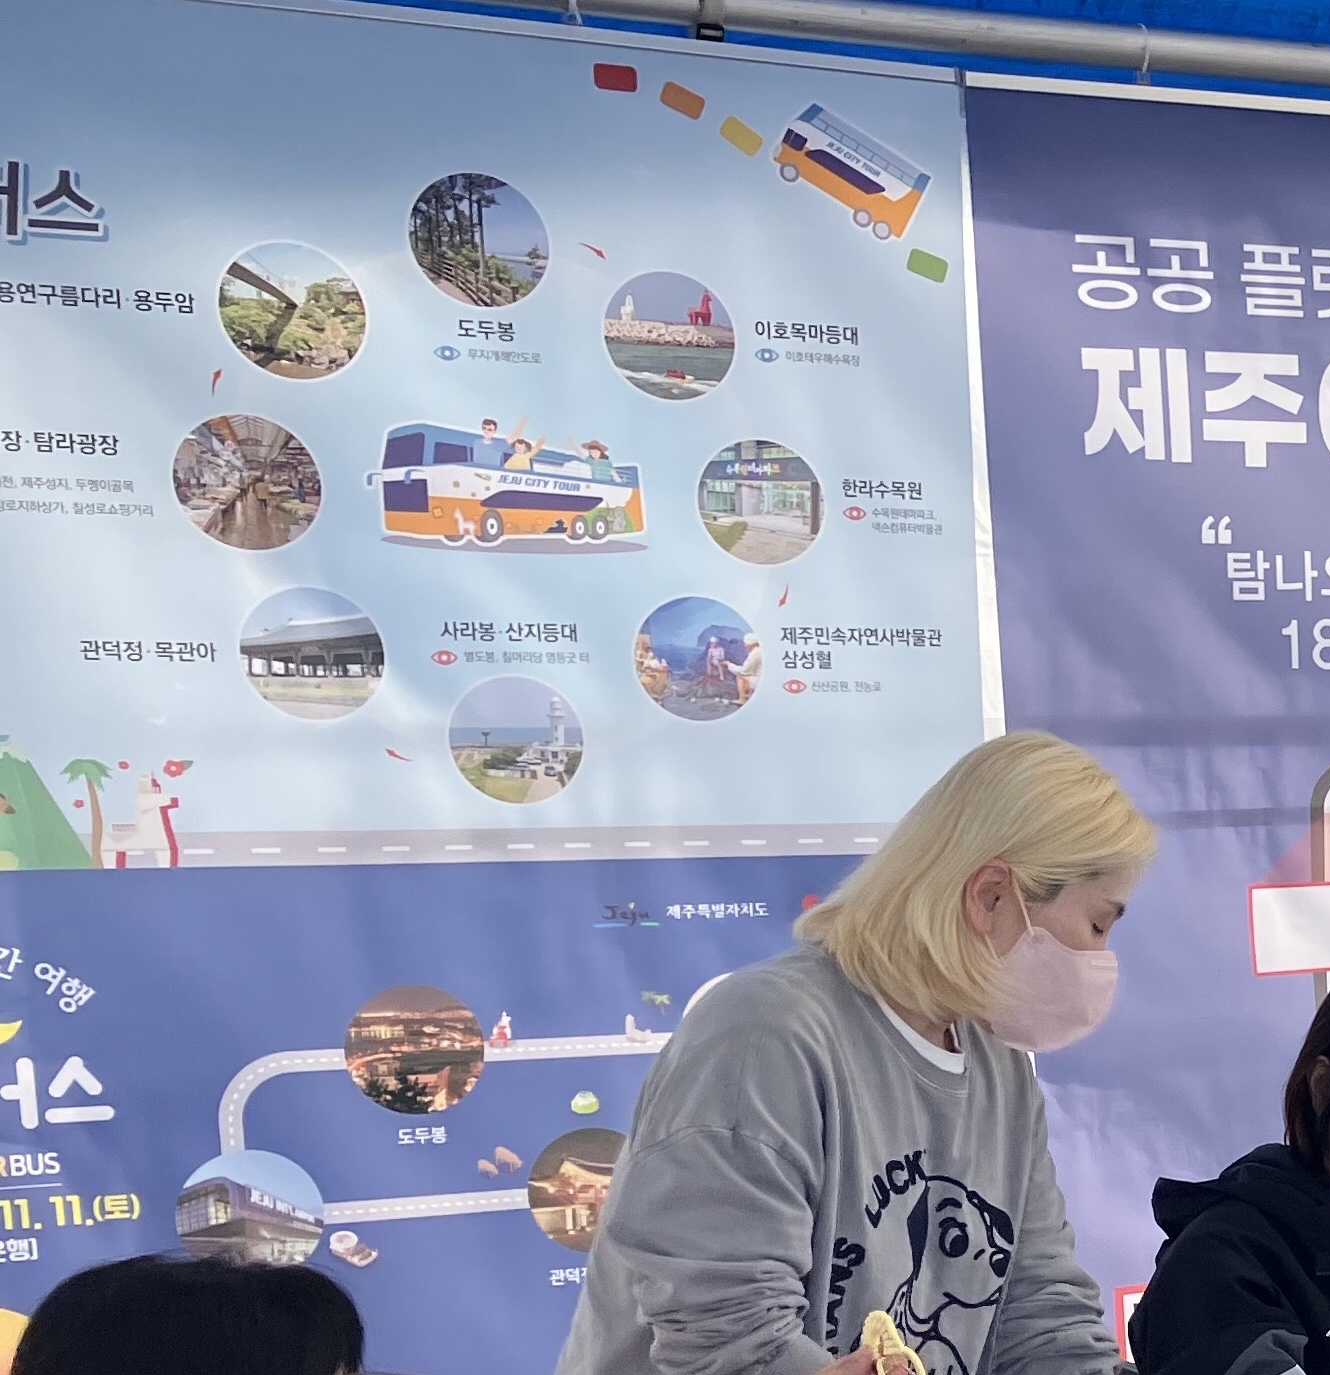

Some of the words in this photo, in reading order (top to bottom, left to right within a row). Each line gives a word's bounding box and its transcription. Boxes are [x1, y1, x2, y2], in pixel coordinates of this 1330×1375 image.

[1071, 234, 1214, 314] 공공
[458, 319, 516, 342] 도두봉
[755, 321, 859, 346] 이호목마등대
[498, 474, 523, 486] JEJU
[524, 477, 551, 489] CITY
[552, 480, 581, 492] TOUR
[842, 479, 923, 500] 한라수목원
[780, 626, 943, 648] 제주민속자연사박물관
[782, 650, 832, 670] 삼성혈
[666, 902, 769, 920] 제주특별자치도
[34, 962, 96, 1013] 여행
[397, 1125, 447, 1146] 도두봉
